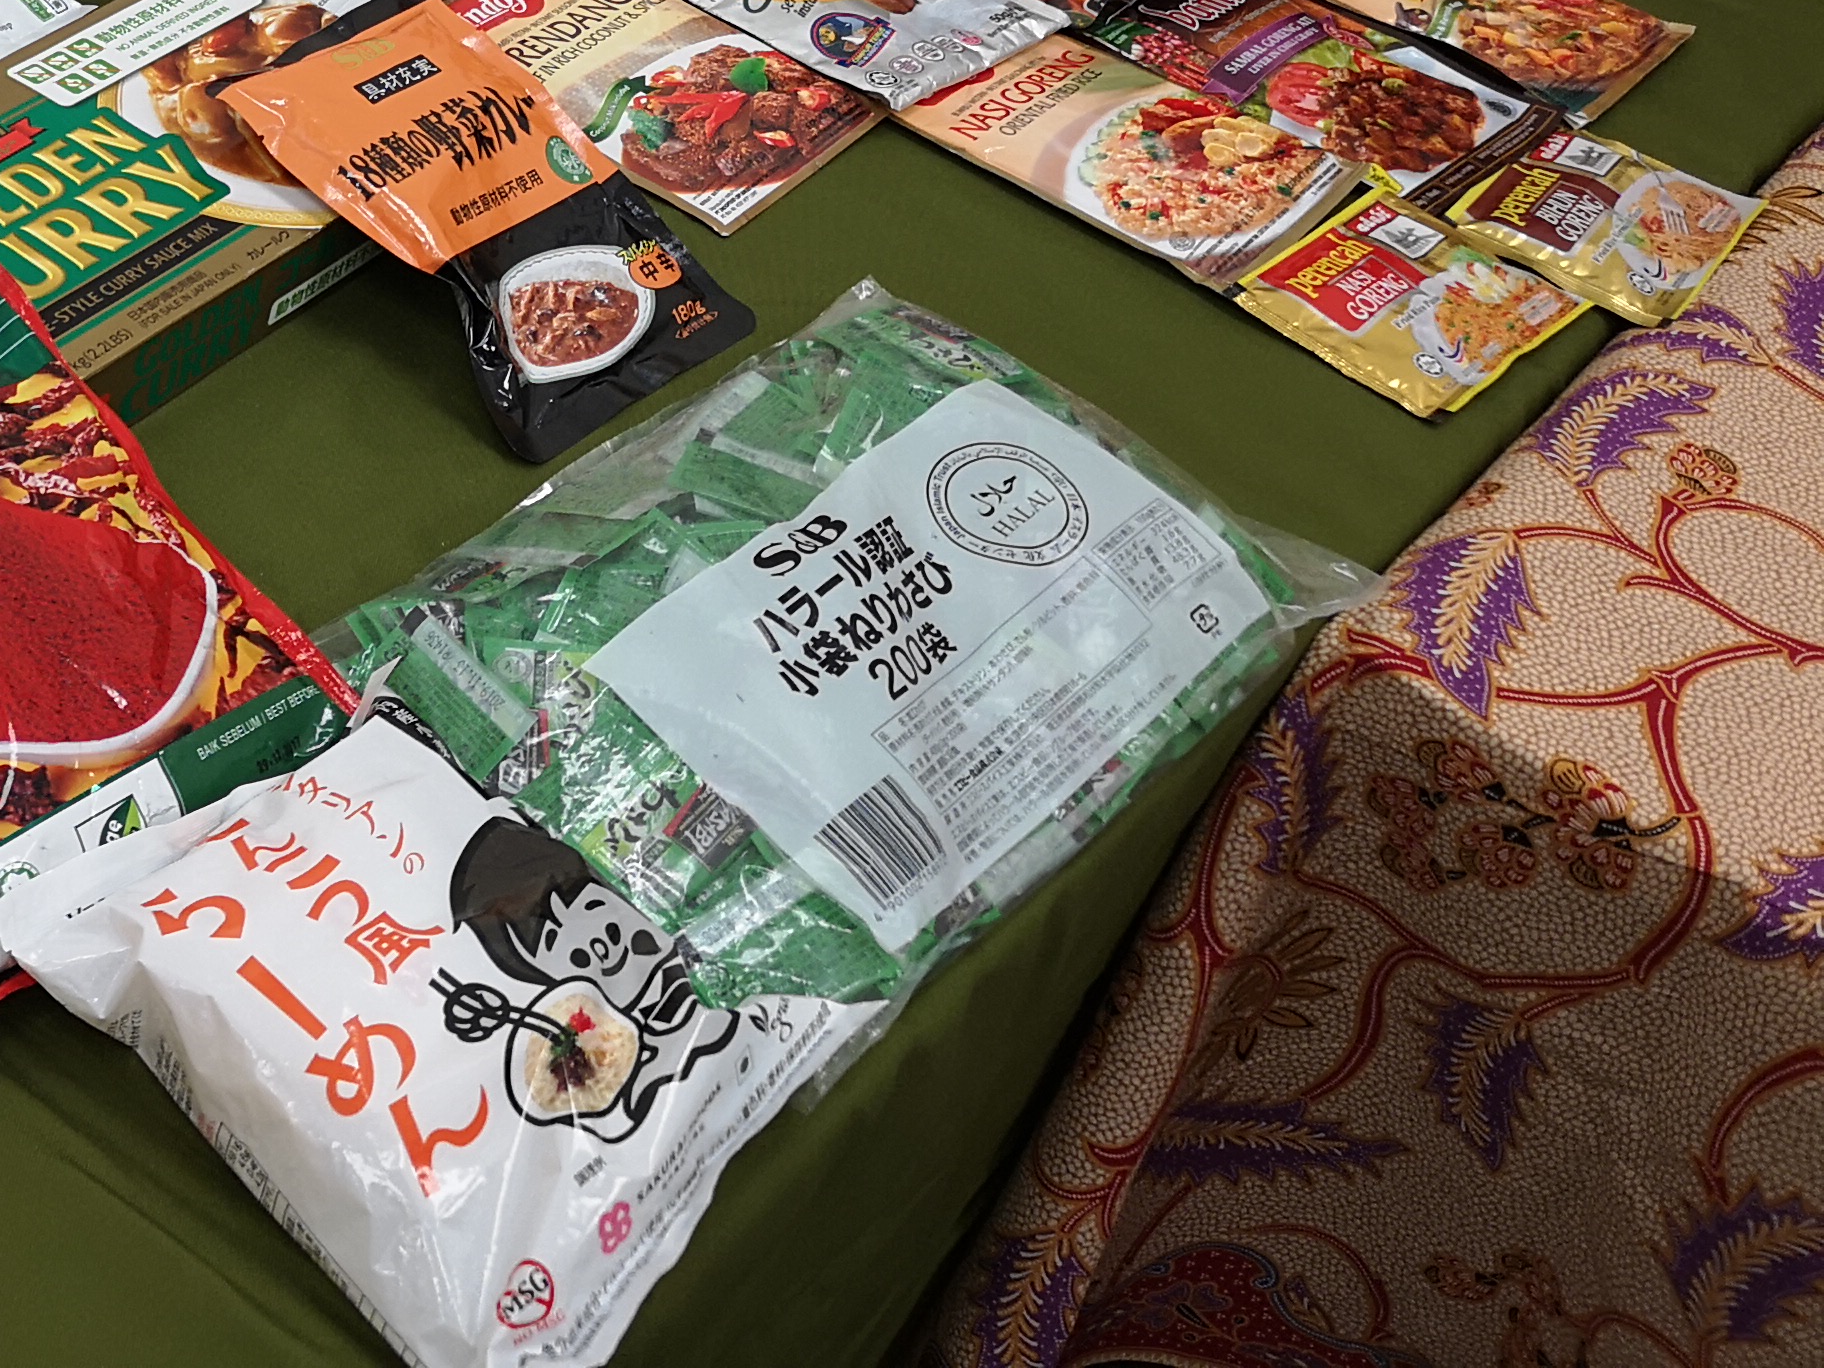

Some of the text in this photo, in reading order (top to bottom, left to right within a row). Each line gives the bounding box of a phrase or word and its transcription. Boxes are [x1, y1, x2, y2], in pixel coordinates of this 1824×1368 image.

[128, 29, 159, 46] ANIMAL
[157, 10, 191, 33] DERIVED
[331, 37, 398, 72] S&B
[540, 60, 560, 77] IN
[557, 43, 584, 66] RICH
[578, 15, 630, 52] COCONUT
[1223, 23, 1299, 76] SAMBAL GORENG
[359, 56, 440, 103] 具材充実
[1246, 54, 1272, 76] LIVER
[948, 49, 1096, 142] NASI GORENG
[998, 67, 1104, 137] ORIENTAL FRIED RICE
[1538, 136, 1569, 162] adabi
[447, 168, 546, 227] 動物性原材料不使用
[1354, 205, 1392, 235] adabi
[1491, 165, 1561, 227] perencah
[1535, 188, 1578, 226] BIHUN
[1554, 193, 1603, 244] GORENG
[99, 220, 220, 298] CURRY SAUCE MIX
[639, 252, 679, 284] 中辛
[1284, 230, 1374, 299] perencah
[1335, 267, 1377, 297] NASI
[671, 298, 708, 326] 180g
[1345, 272, 1410, 322] GORENG
[132, 276, 265, 381] GOLDEN
[932, 460, 967, 541] Japan Islamic Trust
[991, 488, 1056, 539] HALAL
[753, 514, 849, 577] S&B
[752, 514, 916, 654] ハラール認証
[777, 550, 955, 698] 小袋ねりわさび
[867, 620, 959, 702] 200袋
[196, 684, 323, 762] BAIK SEBELUM BEST BEFORE
[139, 887, 490, 1199] らーめん
[500, 1266, 550, 1323] MSG
